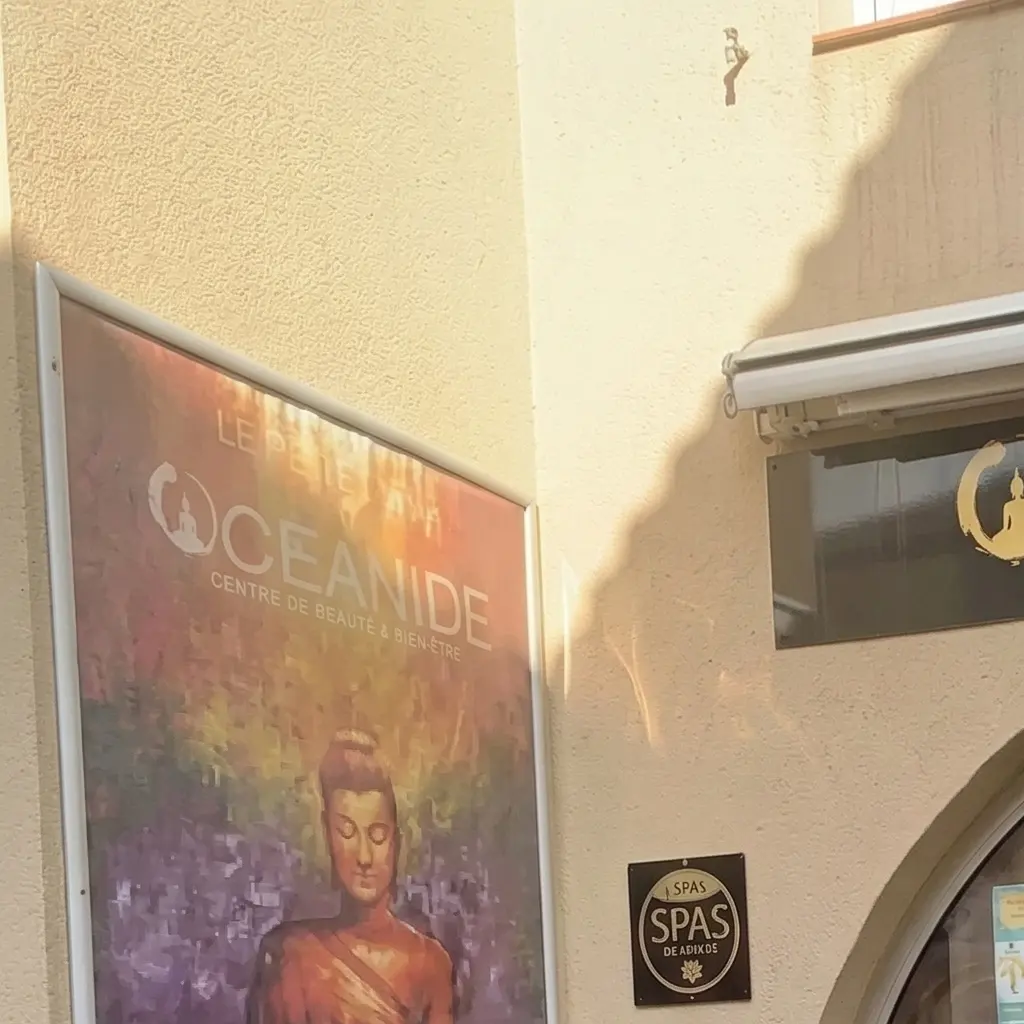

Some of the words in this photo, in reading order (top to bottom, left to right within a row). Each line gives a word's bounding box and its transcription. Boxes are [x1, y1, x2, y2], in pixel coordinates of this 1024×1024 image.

[148, 461, 492, 652] OCEANIDE
[211, 571, 281, 607] CENTRE
[288, 595, 309, 615] DE
[380, 624, 389, 639] &
[674, 880, 707, 896] SPAS
[651, 903, 730, 944] SPAS
[664, 946, 678, 957] DE
